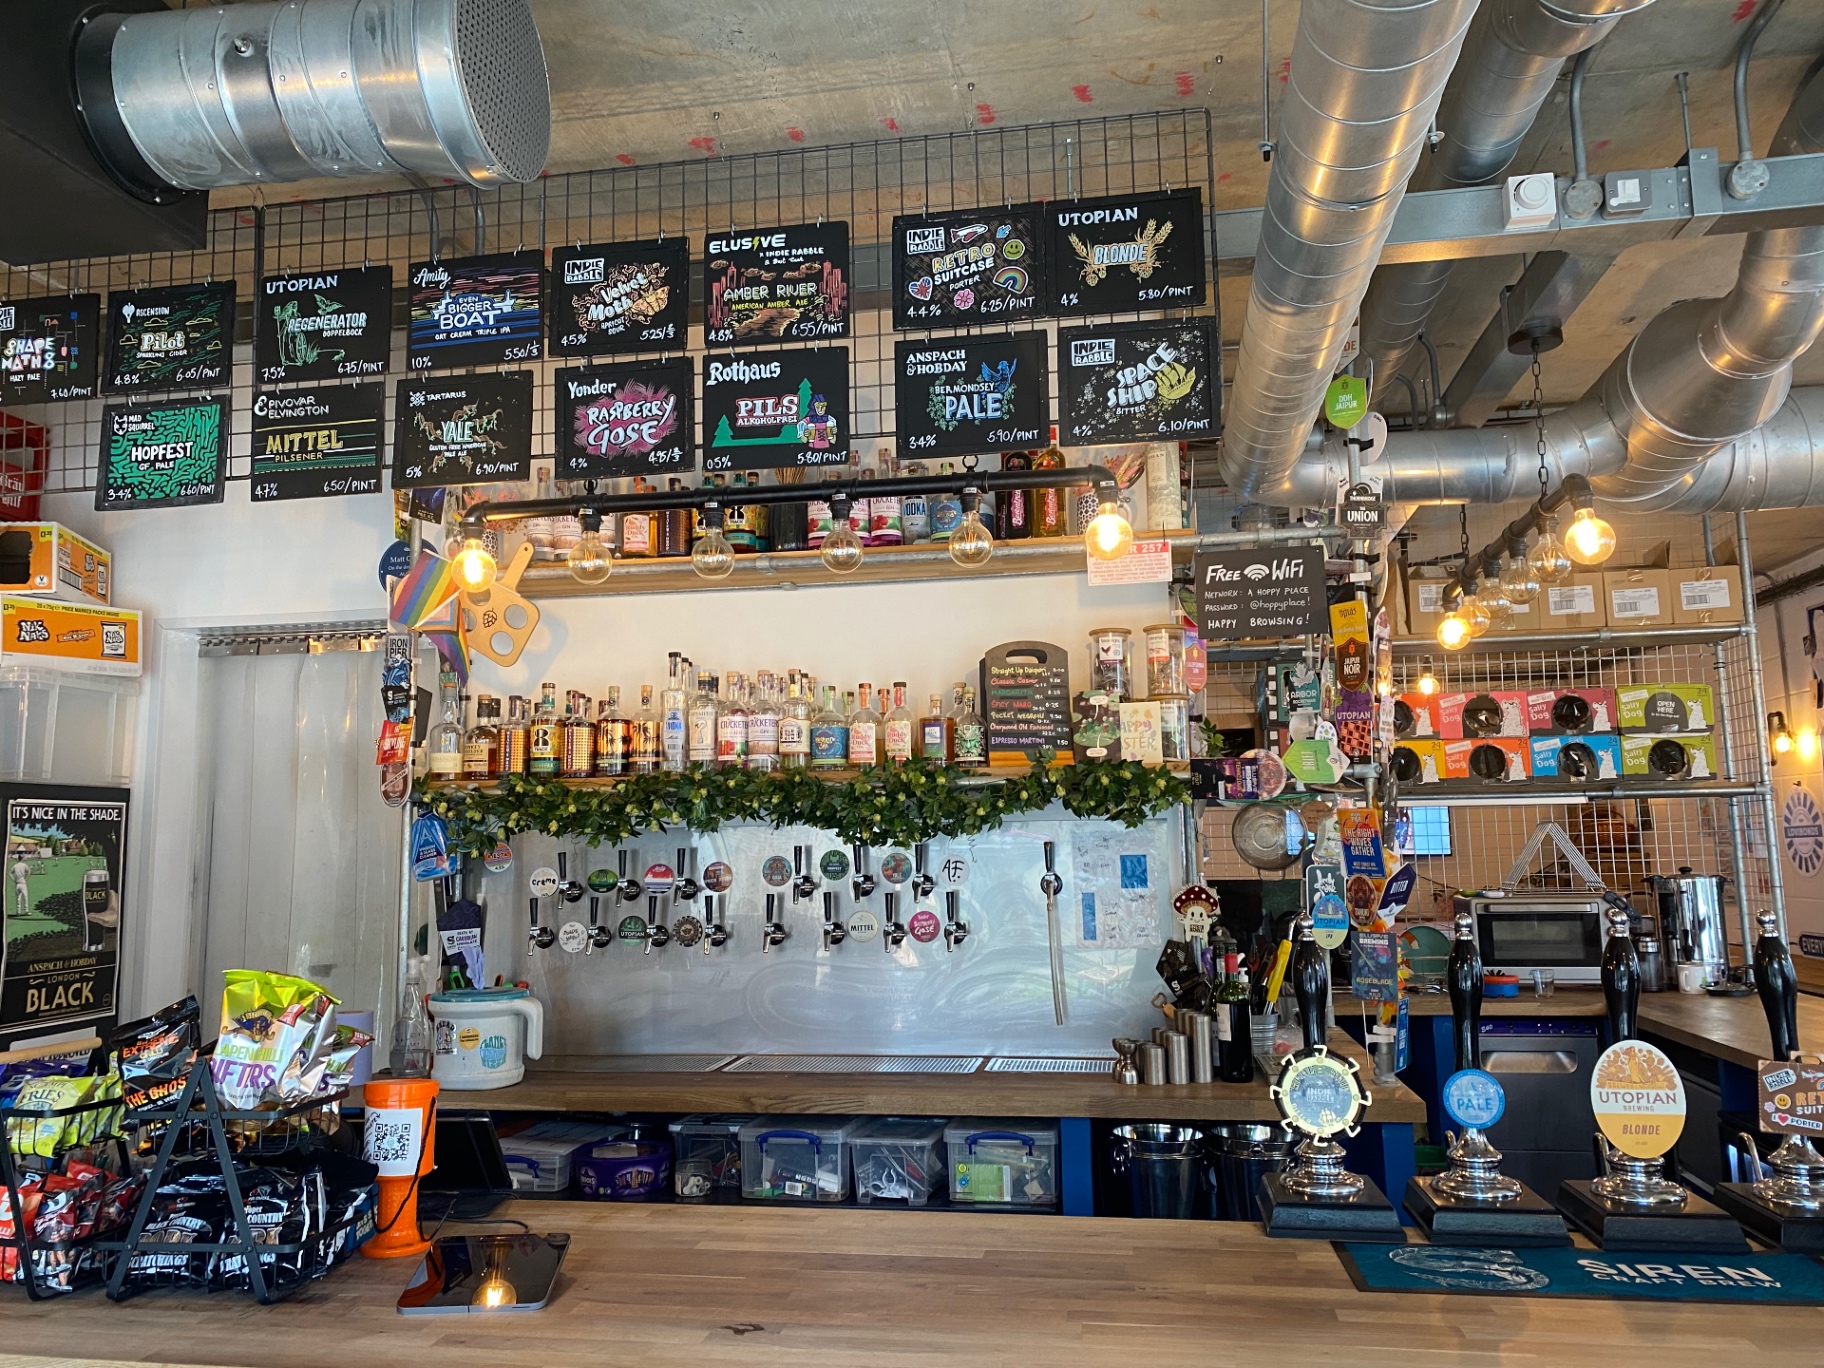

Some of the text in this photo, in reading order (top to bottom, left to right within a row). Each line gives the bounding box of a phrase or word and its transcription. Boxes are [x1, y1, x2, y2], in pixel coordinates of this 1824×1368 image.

[1058, 207, 1138, 227] UTOPIAN
[909, 229, 943, 241] INDIE
[766, 249, 790, 257] INDIE
[792, 247, 824, 255] RABBLE
[910, 240, 943, 252] RABBLE
[932, 242, 996, 274] RETRO
[1094, 242, 1149, 265] BLONDE
[566, 260, 603, 275] INDIE
[934, 257, 995, 285] SUITCASE
[413, 267, 451, 289] Amity
[567, 269, 602, 283] RABBLE
[266, 275, 338, 294] UTOPIAN
[600, 272, 648, 304] Velvet
[950, 275, 980, 291] PORTER
[724, 282, 817, 301] AMBER RIVER
[981, 294, 1035, 313] 6.25/PINT
[1061, 293, 1079, 306] 4%
[136, 307, 170, 317] ASCENSION
[448, 301, 492, 313] BIGGER
[588, 295, 633, 322] Moth
[907, 304, 941, 318] 4.4%
[288, 312, 367, 333] REGENERATOR
[440, 310, 501, 329] BOAT
[601, 316, 625, 330] APRICOT
[322, 328, 363, 338] DOPPELBOCK
[608, 325, 625, 335] SOUR
[709, 329, 733, 341] 4.8%
[4, 336, 57, 356] SHAPE
[140, 330, 185, 352] Pilot
[169, 348, 187, 357] CIDER
[1074, 341, 1113, 355] INDIE
[412, 356, 432, 369] 10%
[906, 349, 966, 364] ANSPACH
[1075, 353, 1112, 364] RABBLE
[2, 354, 41, 372] MATH
[1116, 341, 1178, 388] SPACE
[706, 360, 781, 386] Rothaus
[114, 373, 139, 386] 4.8%
[568, 379, 617, 399] Yonder
[935, 382, 995, 394] BERMONDSEY
[1107, 379, 1158, 408] SHIP
[426, 391, 466, 401] TARTARUS
[1338, 394, 1353, 403] DDH
[268, 396, 315, 409] PIVOVAR
[737, 395, 799, 417] PILS
[945, 392, 1004, 420] PALE
[1335, 401, 1357, 410] JAIPUR
[269, 405, 329, 419] ELVINGTON
[587, 395, 676, 426] RASPBERRY
[1116, 404, 1147, 415] BITTER
[737, 416, 797, 426] ALKOHOLFREI
[1159, 418, 1210, 432] 6.10/PINT
[441, 421, 474, 442] YALE
[1073, 425, 1092, 437] 4%
[266, 429, 343, 454] MITTEL
[131, 442, 193, 461] HOPFEST
[275, 452, 323, 462] PILSENER
[139, 461, 174, 470] GF PALE
[570, 458, 587, 469] 4%
[406, 466, 422, 478] 5%
[1347, 511, 1378, 523] UNION
[1142, 544, 1162, 553] 25?
[1257, 588, 1280, 597] HOPPY
[1284, 587, 1309, 595] PLACE
[1208, 619, 1236, 630] HAPPY
[389, 638, 408, 649] IRON
[1343, 663, 1361, 675] NOIR
[1290, 690, 1317, 698] ARBOR
[1440, 706, 1458, 716] Salty
[1528, 703, 1547, 714] Salty
[1621, 701, 1640, 711] Salty
[1337, 711, 1371, 719] UTOPIAN
[1442, 714, 1460, 723] Dog
[1531, 711, 1550, 720] Dog
[1623, 709, 1642, 718] Dog
[1446, 753, 1464, 763] Salty
[1534, 750, 1552, 760] Salty
[1624, 749, 1643, 759] Salty
[1448, 761, 1466, 770] Dog
[1536, 759, 1555, 768] Dog
[1626, 757, 1645, 766] Dog
[12, 807, 121, 821] IT'S NICE IN THE SHADE.
[1787, 826, 1819, 836] LOVIBONDS
[1351, 846, 1375, 856] GATHER
[85, 891, 106, 900] BLACK
[28, 960, 63, 973] ANSPACH
[70, 956, 97, 968] HOBDAY
[47, 972, 80, 983] LONDON
[25, 981, 94, 1013] BLACK
[126, 1090, 148, 1109] THE
[1599, 1091, 1677, 1104] UTOPIAN
[1457, 1098, 1493, 1111] PALE
[1790, 1118, 1821, 1128] PORTER
[1622, 1124, 1661, 1135] BLONDE
[247, 1212, 285, 1224] COUNTRY
[1577, 1259, 1775, 1281] SIREN
[1592, 1273, 1782, 1288] CRAFT BREW
